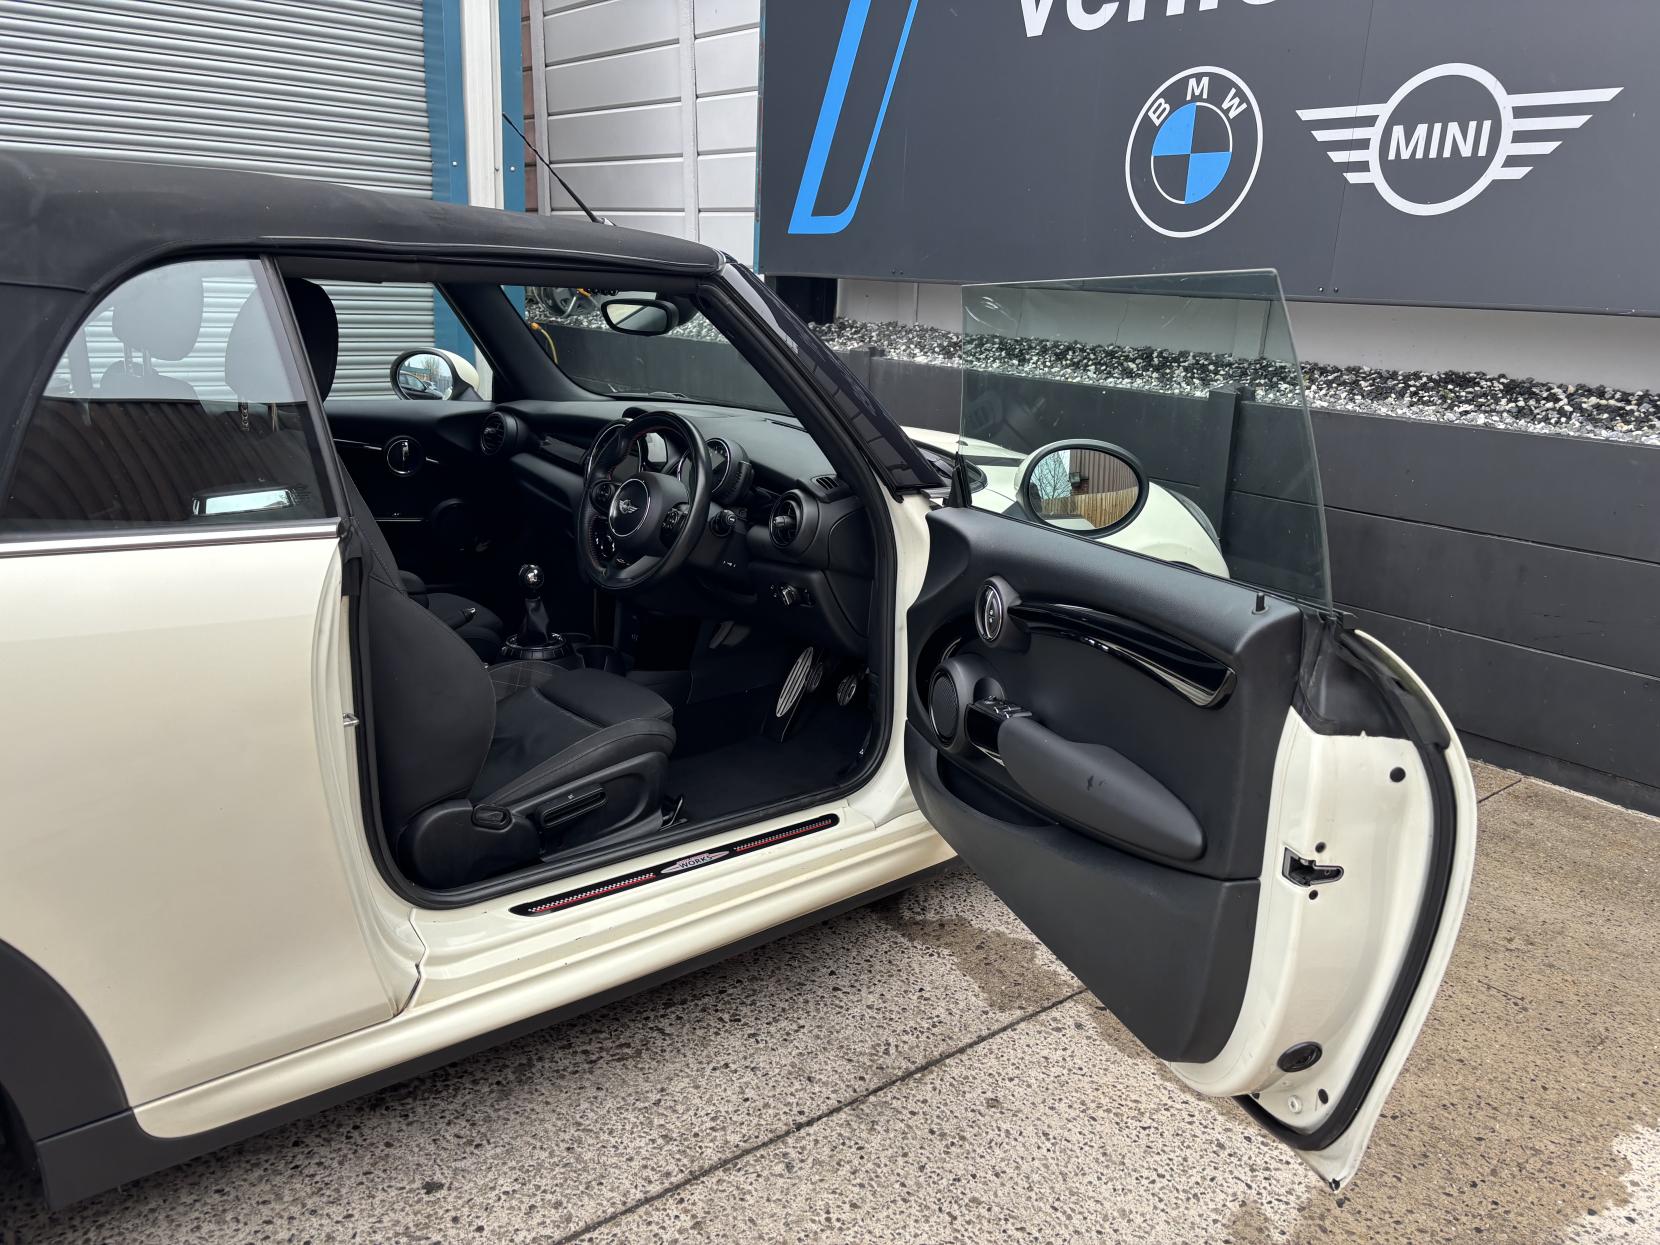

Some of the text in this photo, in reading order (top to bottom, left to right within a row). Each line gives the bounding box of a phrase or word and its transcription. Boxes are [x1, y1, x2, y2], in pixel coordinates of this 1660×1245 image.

[1147, 76, 1248, 127] BMW
[1387, 119, 1492, 161] MINI
[679, 855, 713, 868] WORKS
